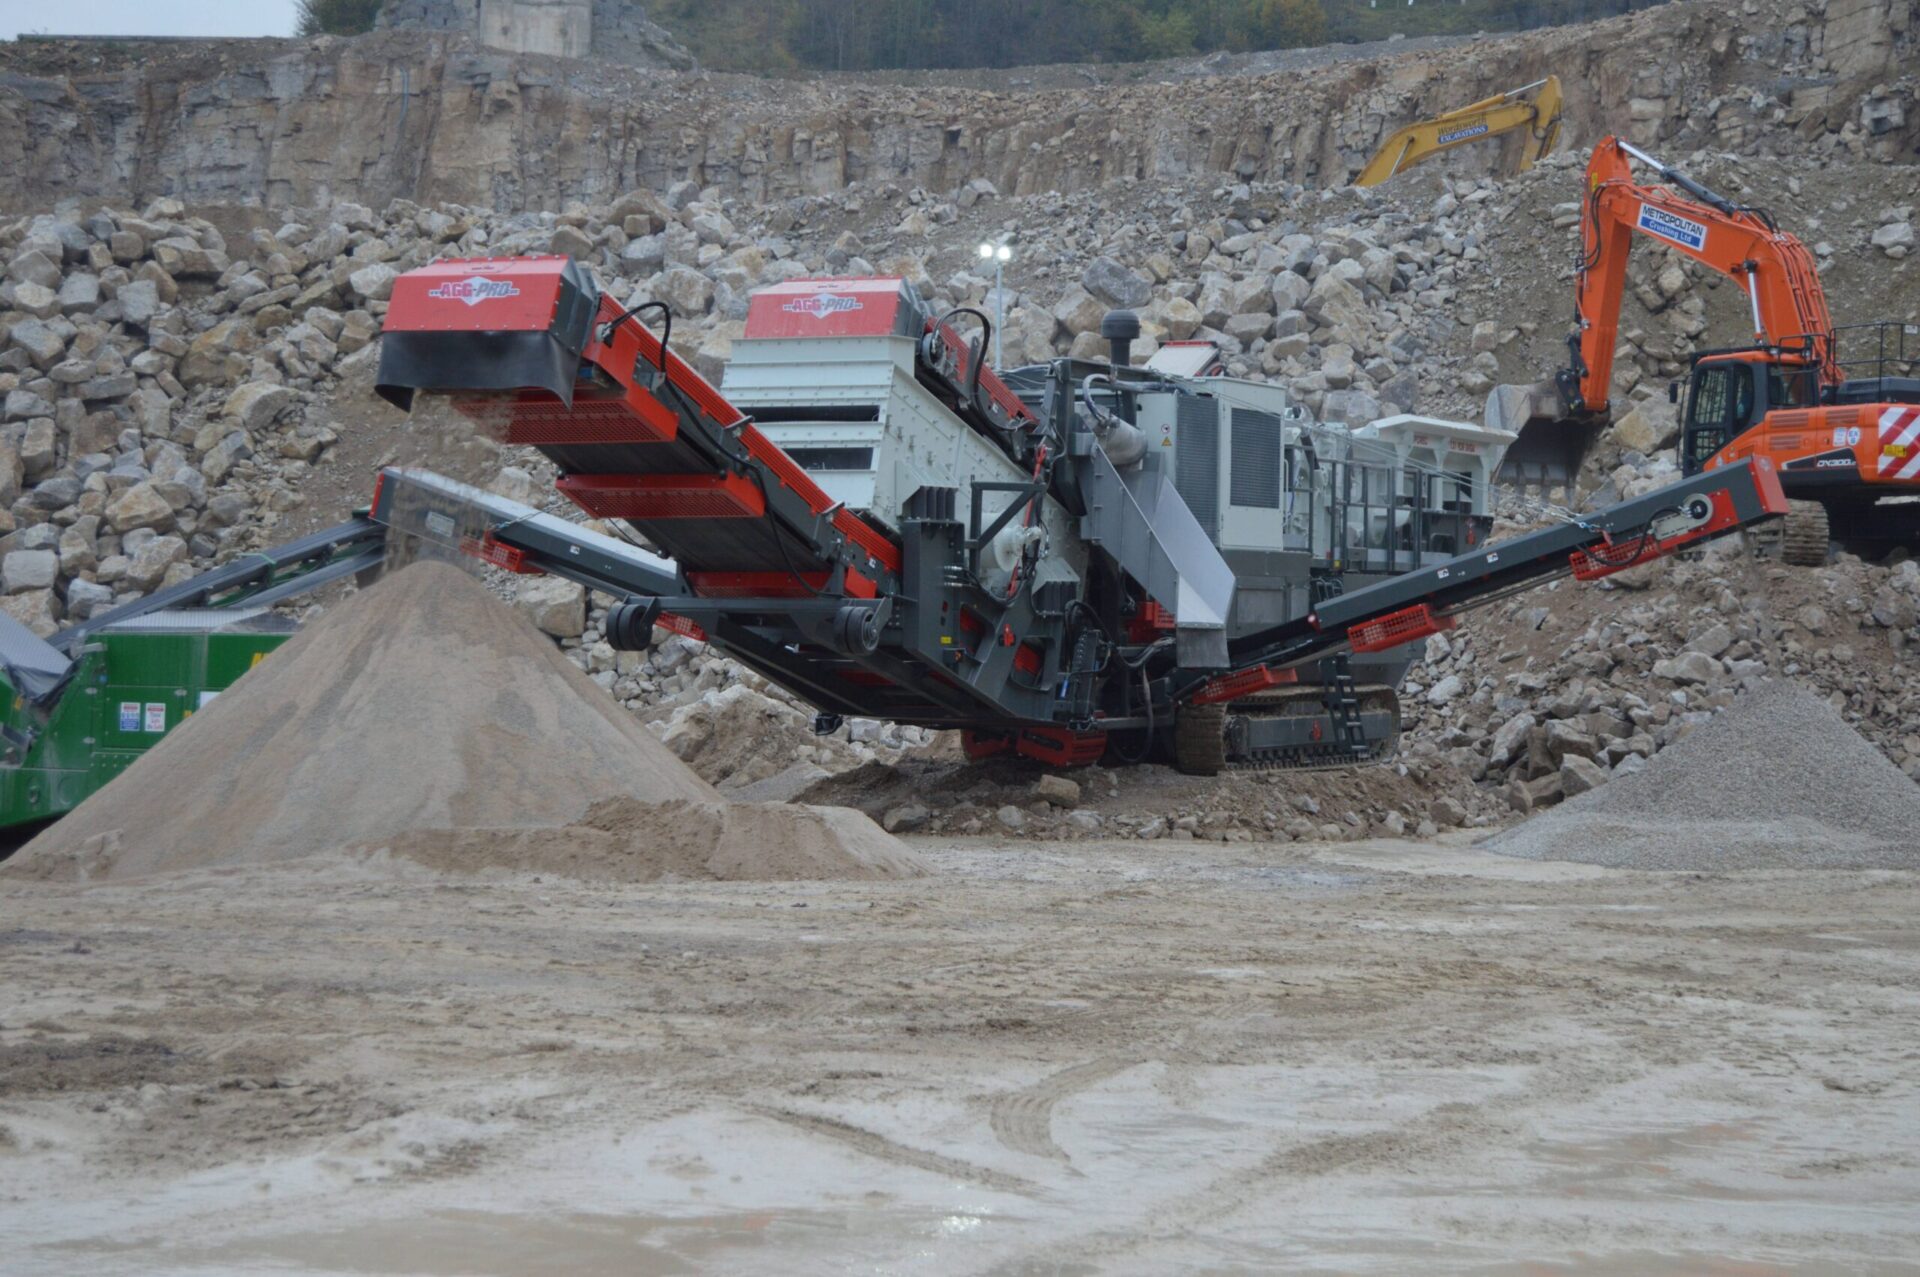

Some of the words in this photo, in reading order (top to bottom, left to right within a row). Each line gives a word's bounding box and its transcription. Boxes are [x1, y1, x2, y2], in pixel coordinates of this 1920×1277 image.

[1440, 126, 1486, 142] EXCAVATIONS
[1642, 205, 1704, 236] METROPOLITAN
[1649, 220, 1679, 240] Crushing
[1680, 232, 1693, 243] Ltd
[440, 281, 513, 298] AGG-PRO
[792, 297, 857, 312] AGG-PRO
